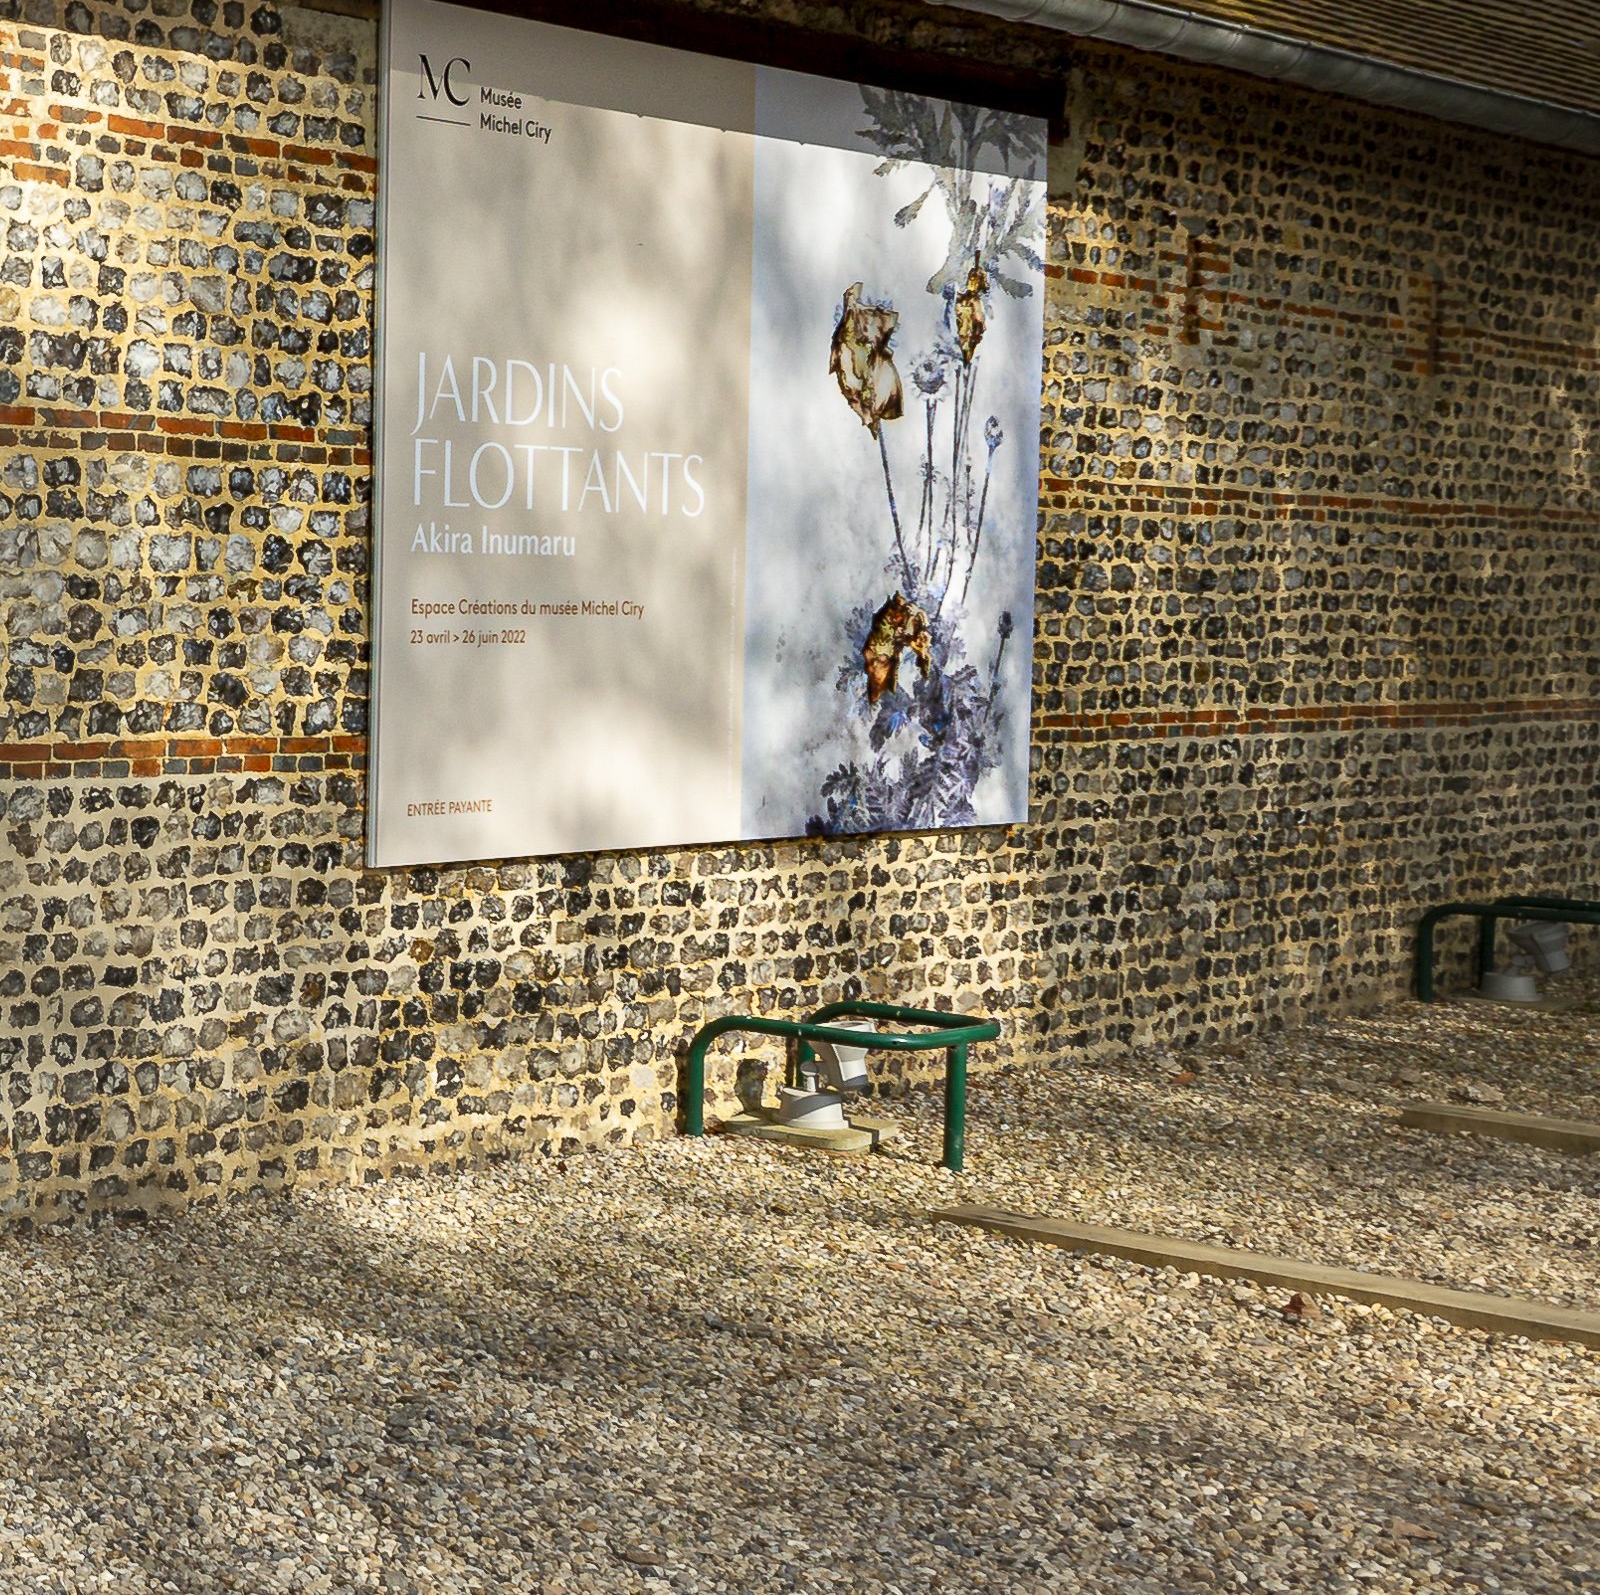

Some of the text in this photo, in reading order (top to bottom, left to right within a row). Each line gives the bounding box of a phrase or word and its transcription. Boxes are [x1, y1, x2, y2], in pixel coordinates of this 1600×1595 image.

[417, 53, 471, 107] MC
[480, 86, 522, 109] Musée
[480, 112, 552, 144] Michel Ciry
[410, 352, 624, 435] JARDINS
[414, 438, 705, 517] FLOTTANTS
[411, 521, 576, 556] Akira Inumaru
[411, 598, 645, 619] Espace Créations du musée Michel Ciry
[410, 629, 424, 644] 23
[426, 629, 451, 644] avril
[462, 629, 476, 644] 26
[477, 629, 499, 648] juin
[500, 629, 526, 644] 2022
[407, 799, 493, 817] ENTRÉE PAYANTE
